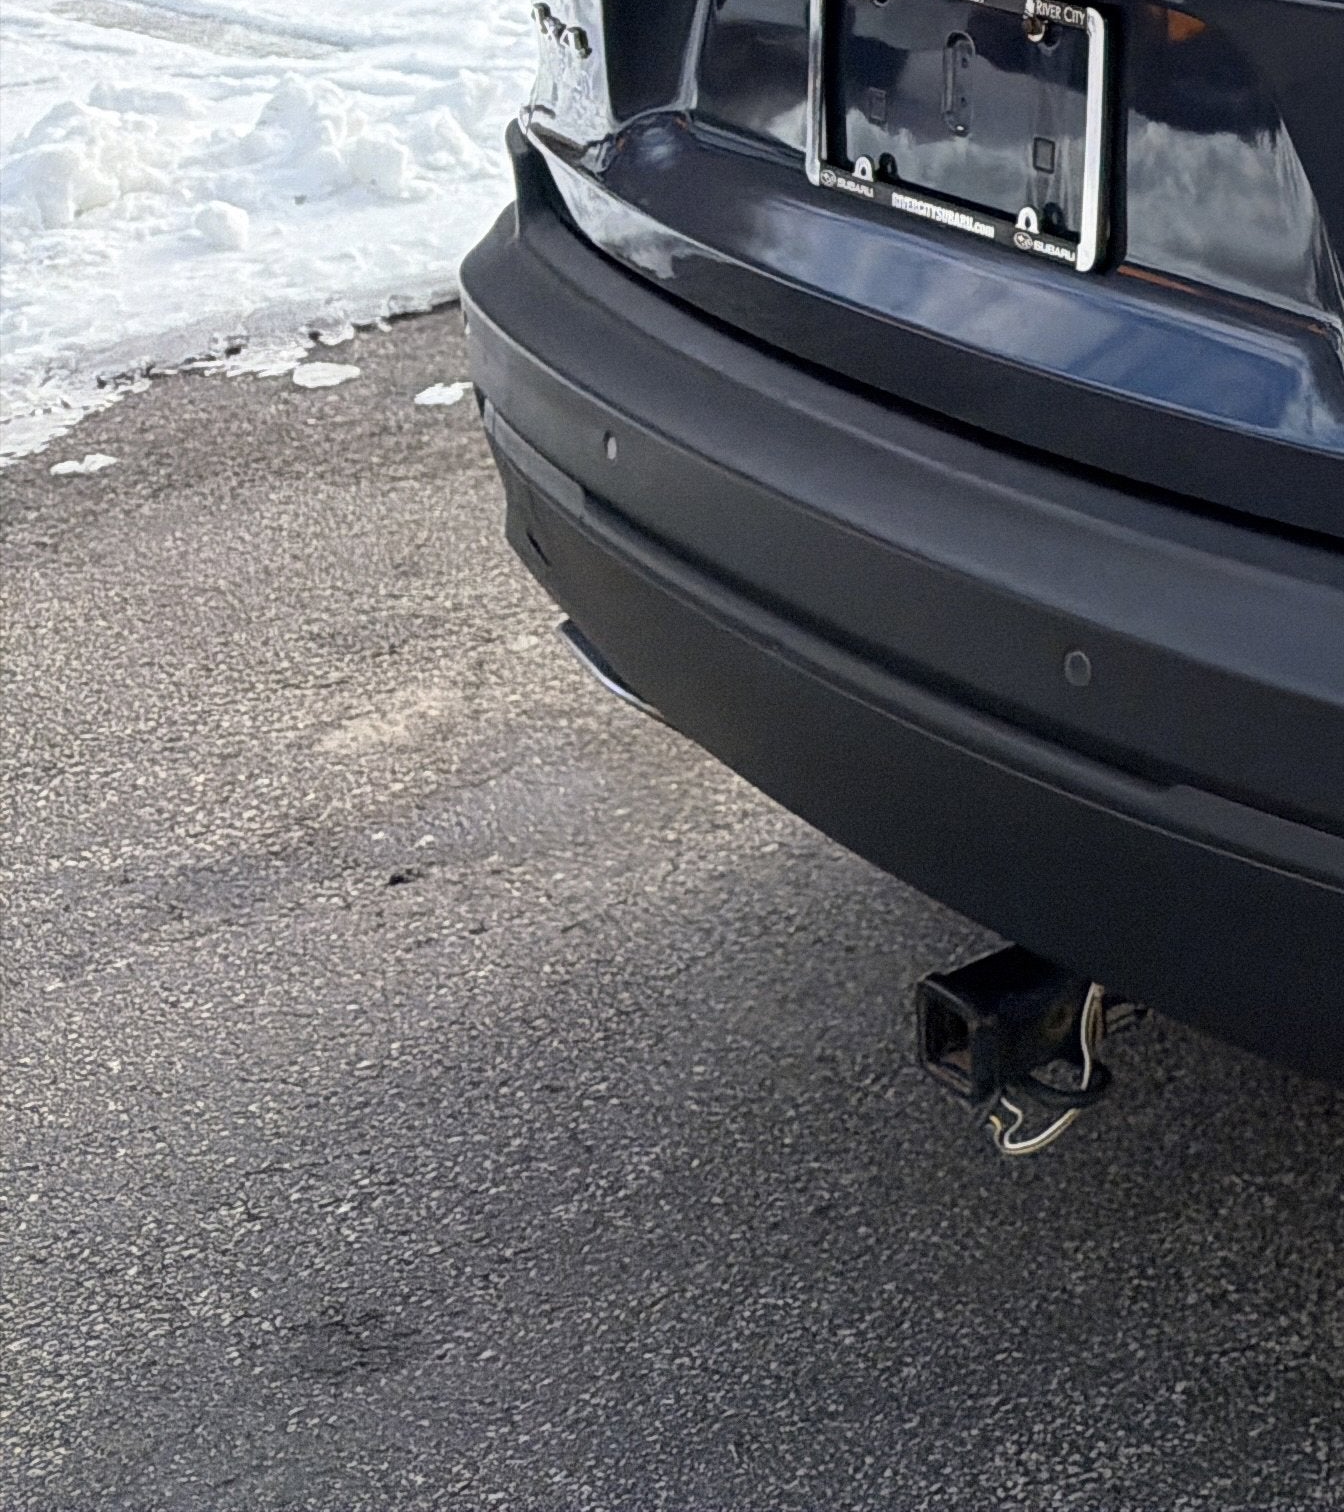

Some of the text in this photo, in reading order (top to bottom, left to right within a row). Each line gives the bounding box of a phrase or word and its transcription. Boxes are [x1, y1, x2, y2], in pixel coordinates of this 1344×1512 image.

[1035, 0, 1086, 26] RIVER CITY
[836, 177, 874, 198] SUBARU
[891, 192, 995, 238] RIVERCITYSUBARU.com
[1032, 240, 1076, 262] SUBARU
